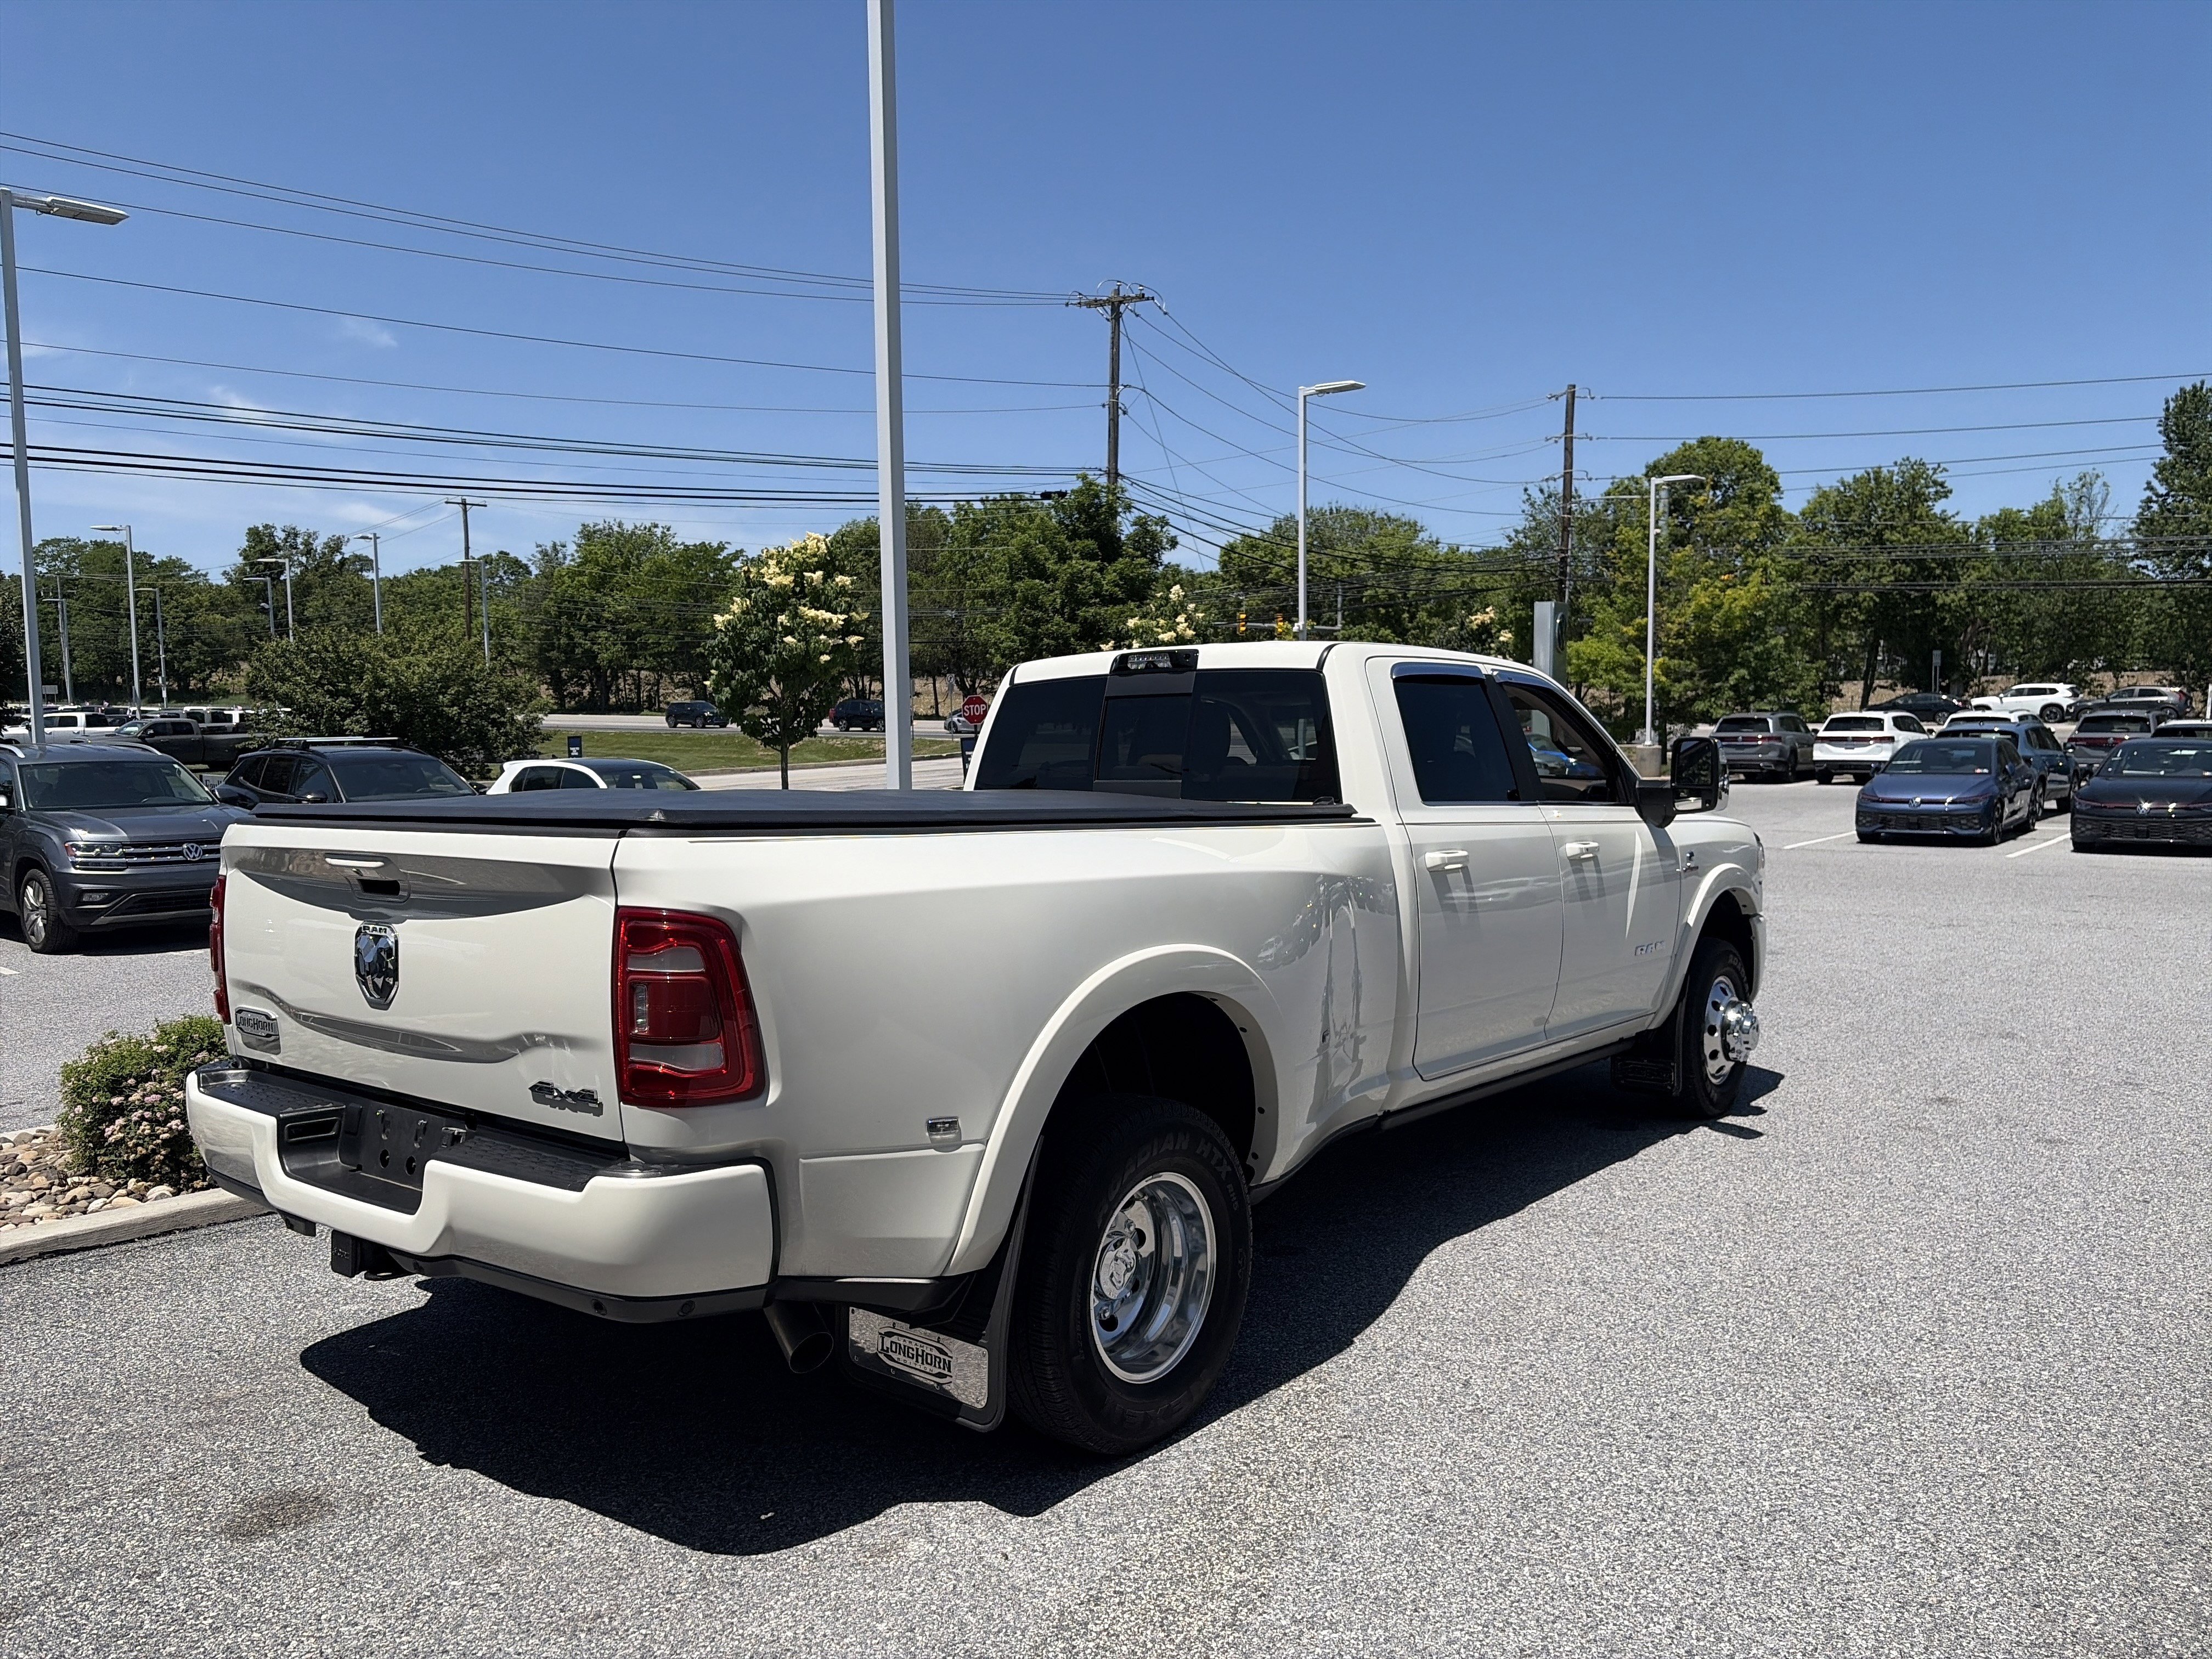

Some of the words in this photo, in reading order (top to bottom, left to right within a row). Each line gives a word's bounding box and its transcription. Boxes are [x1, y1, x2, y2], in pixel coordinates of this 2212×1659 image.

[964, 704, 986, 716] STOP
[363, 926, 387, 935] RAM
[1634, 941, 1665, 956] RAM
[235, 1014, 273, 1032] LONGHORN
[1196, 1138, 1232, 1180] HTX
[898, 1336, 934, 1352] LARAMIE
[880, 1335, 952, 1374] LONGHORN
[897, 1357, 934, 1373] EDITION
